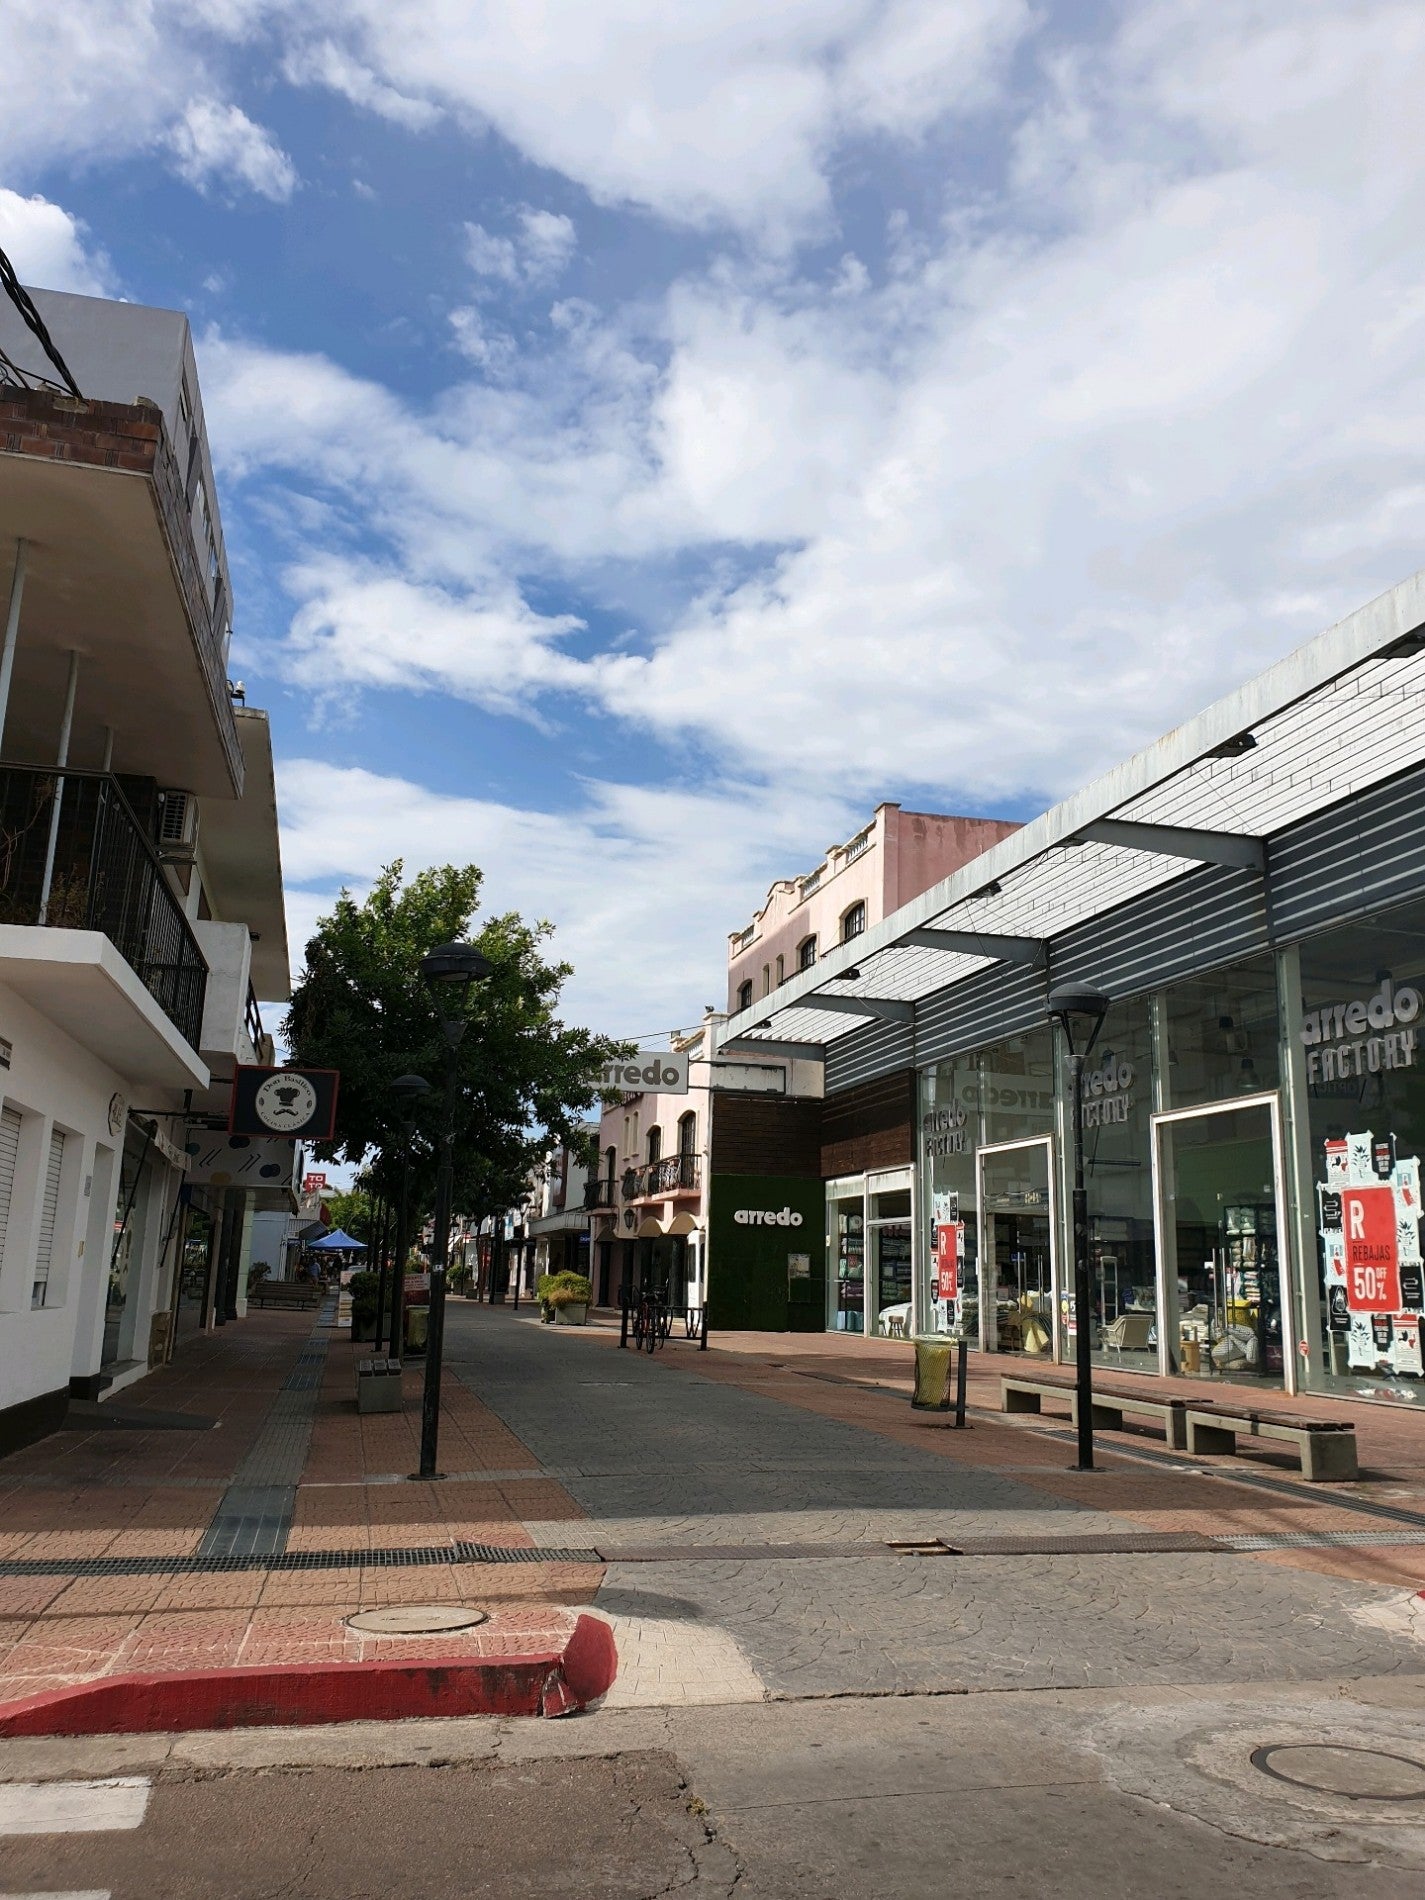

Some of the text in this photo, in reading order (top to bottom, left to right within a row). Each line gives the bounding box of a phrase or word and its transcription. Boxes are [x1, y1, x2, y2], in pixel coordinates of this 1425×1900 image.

[1300, 978, 1421, 1045] arredo
[1307, 1029, 1416, 1085] FACTORY
[263, 1075, 311, 1096] Don Basilico
[734, 1207, 803, 1226] arredo
[1349, 1200, 1366, 1239] R
[940, 1232, 947, 1255] R
[1352, 1245, 1391, 1261] REBAJAS
[941, 1272, 949, 1291] 50
[1353, 1266, 1376, 1300] 50
[1376, 1267, 1387, 1280] OFF
